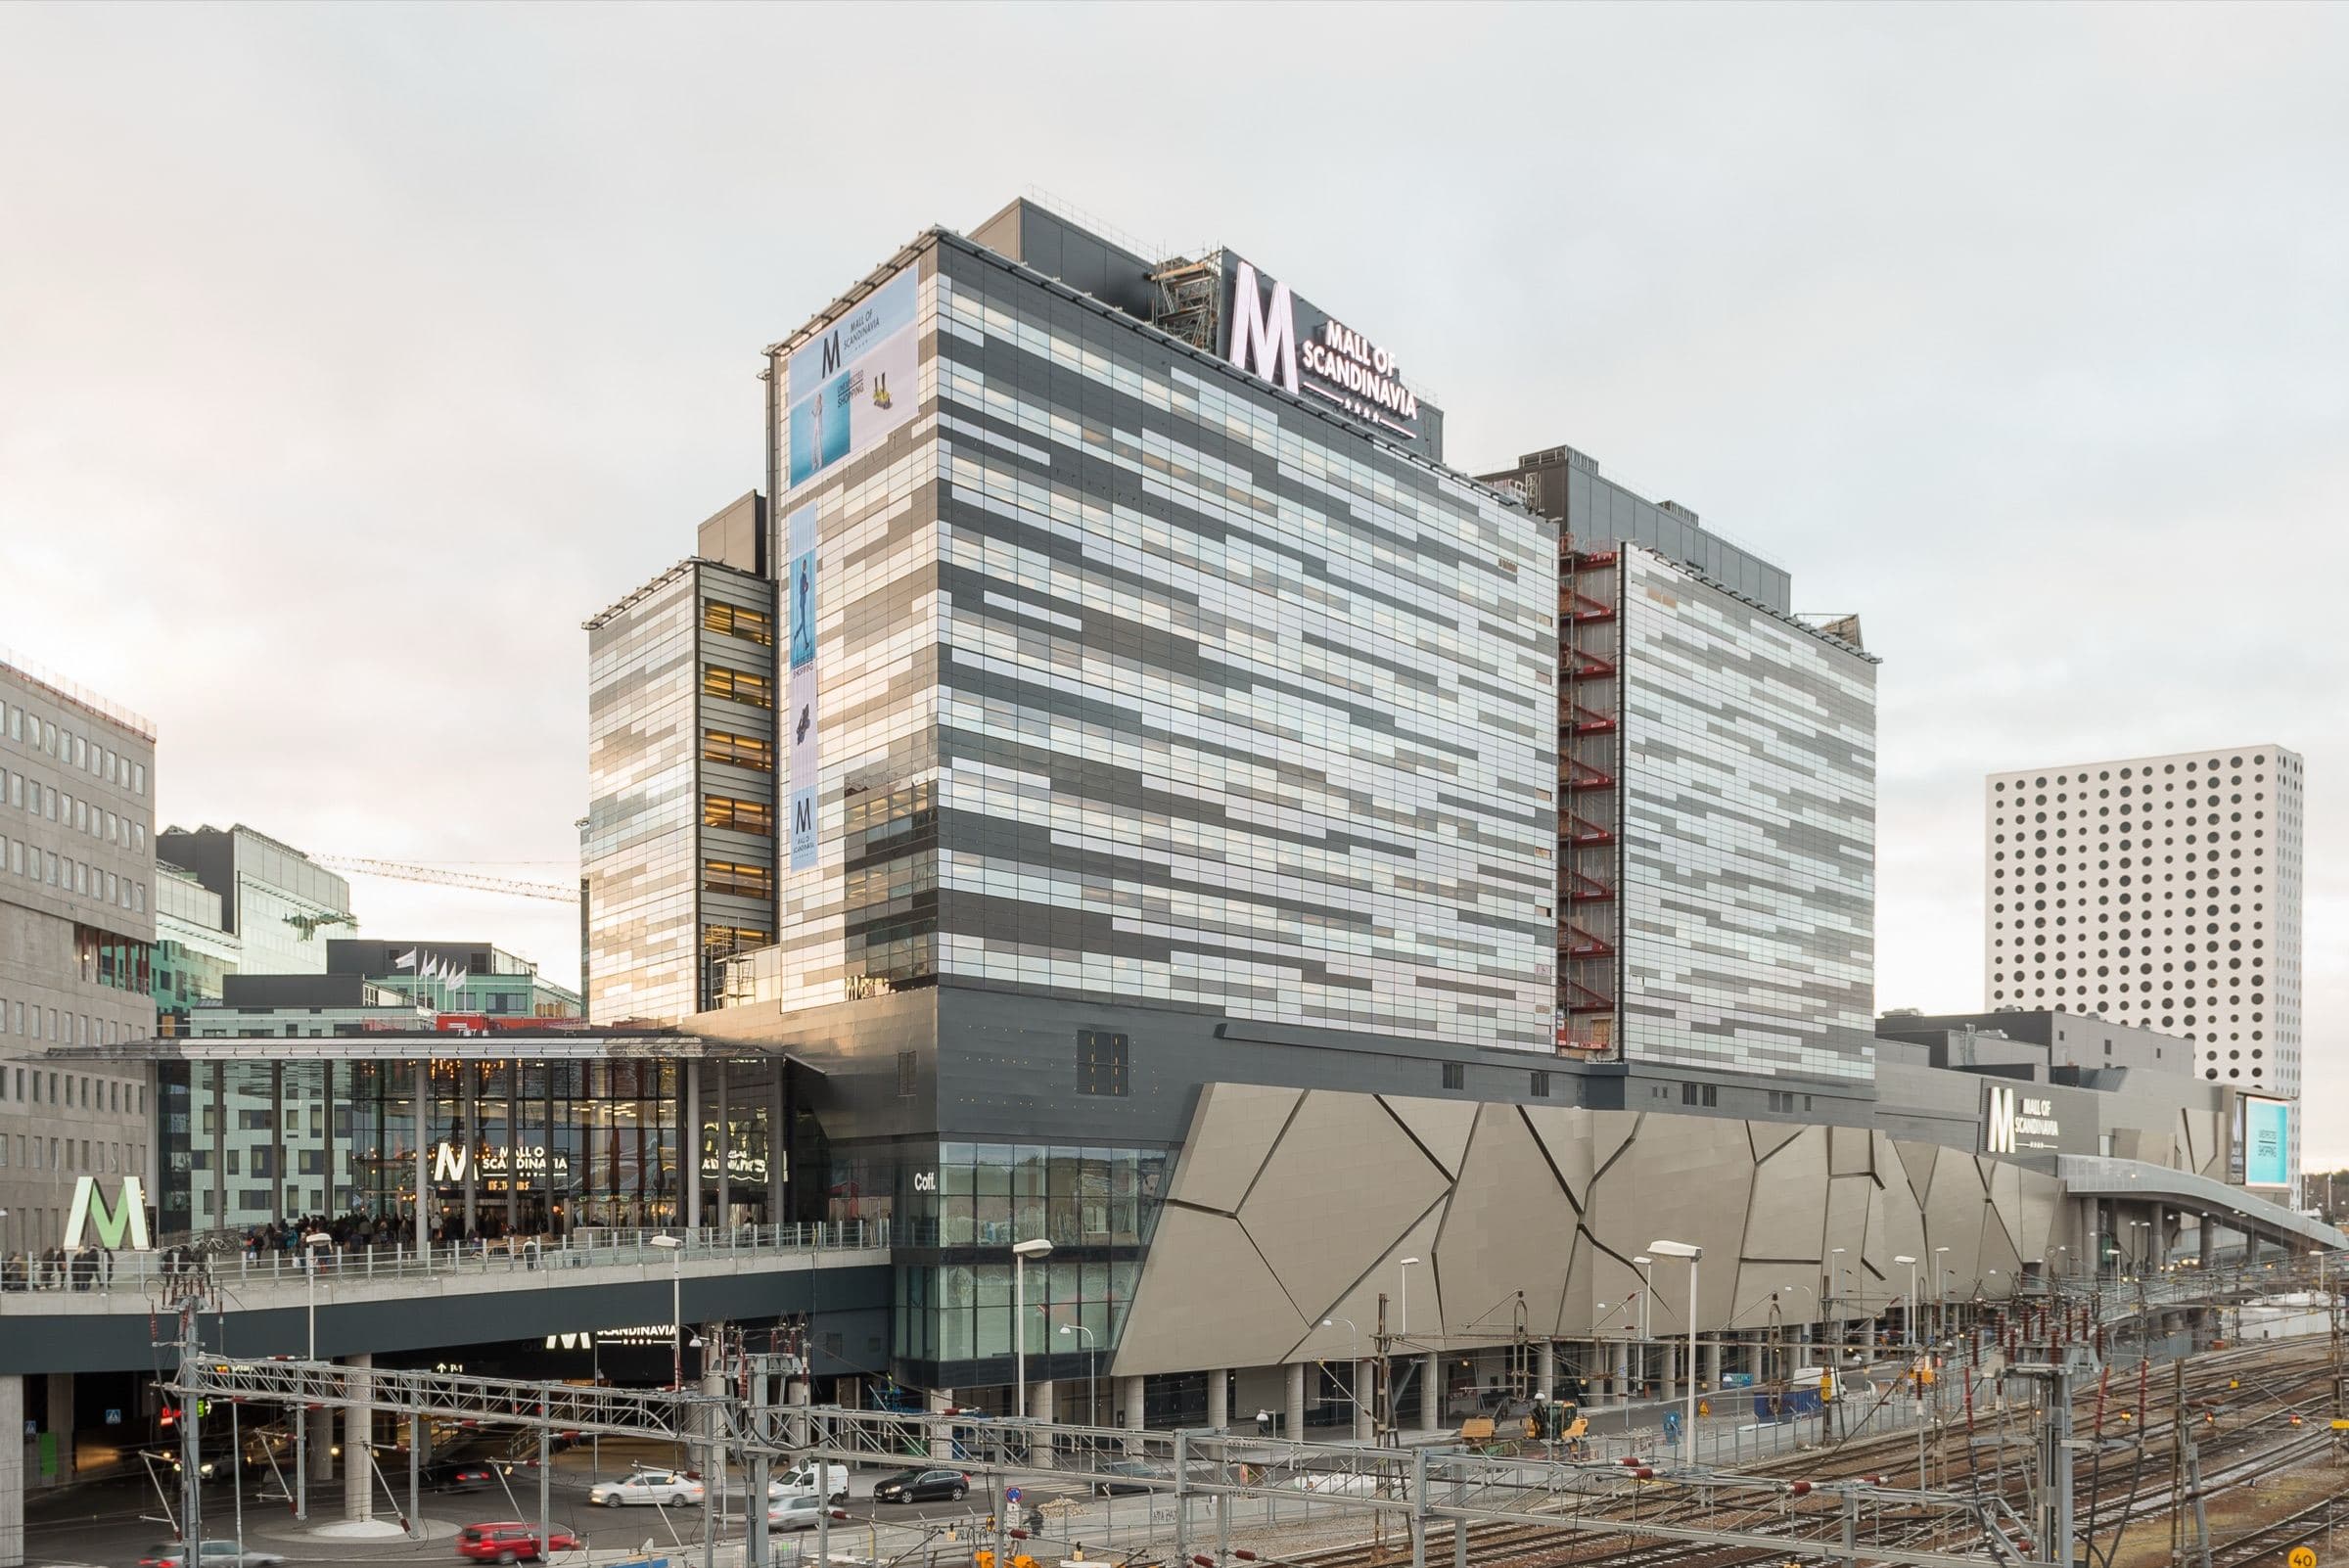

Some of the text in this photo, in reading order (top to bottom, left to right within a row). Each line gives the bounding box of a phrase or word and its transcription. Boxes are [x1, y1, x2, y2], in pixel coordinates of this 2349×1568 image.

[1229, 261, 1299, 394] M
[1325, 320, 1396, 377] MALL OF
[822, 330, 841, 380] M
[1302, 340, 1417, 420] SCANDINAVIA
[796, 797, 811, 834] M
[1988, 1086, 2016, 1153] M
[2022, 1098, 2051, 1117] MALL OF
[483, 1158, 568, 1170] SCADINAIA
[64, 1176, 150, 1250] M
[2293, 1553, 2313, 1567] 40
